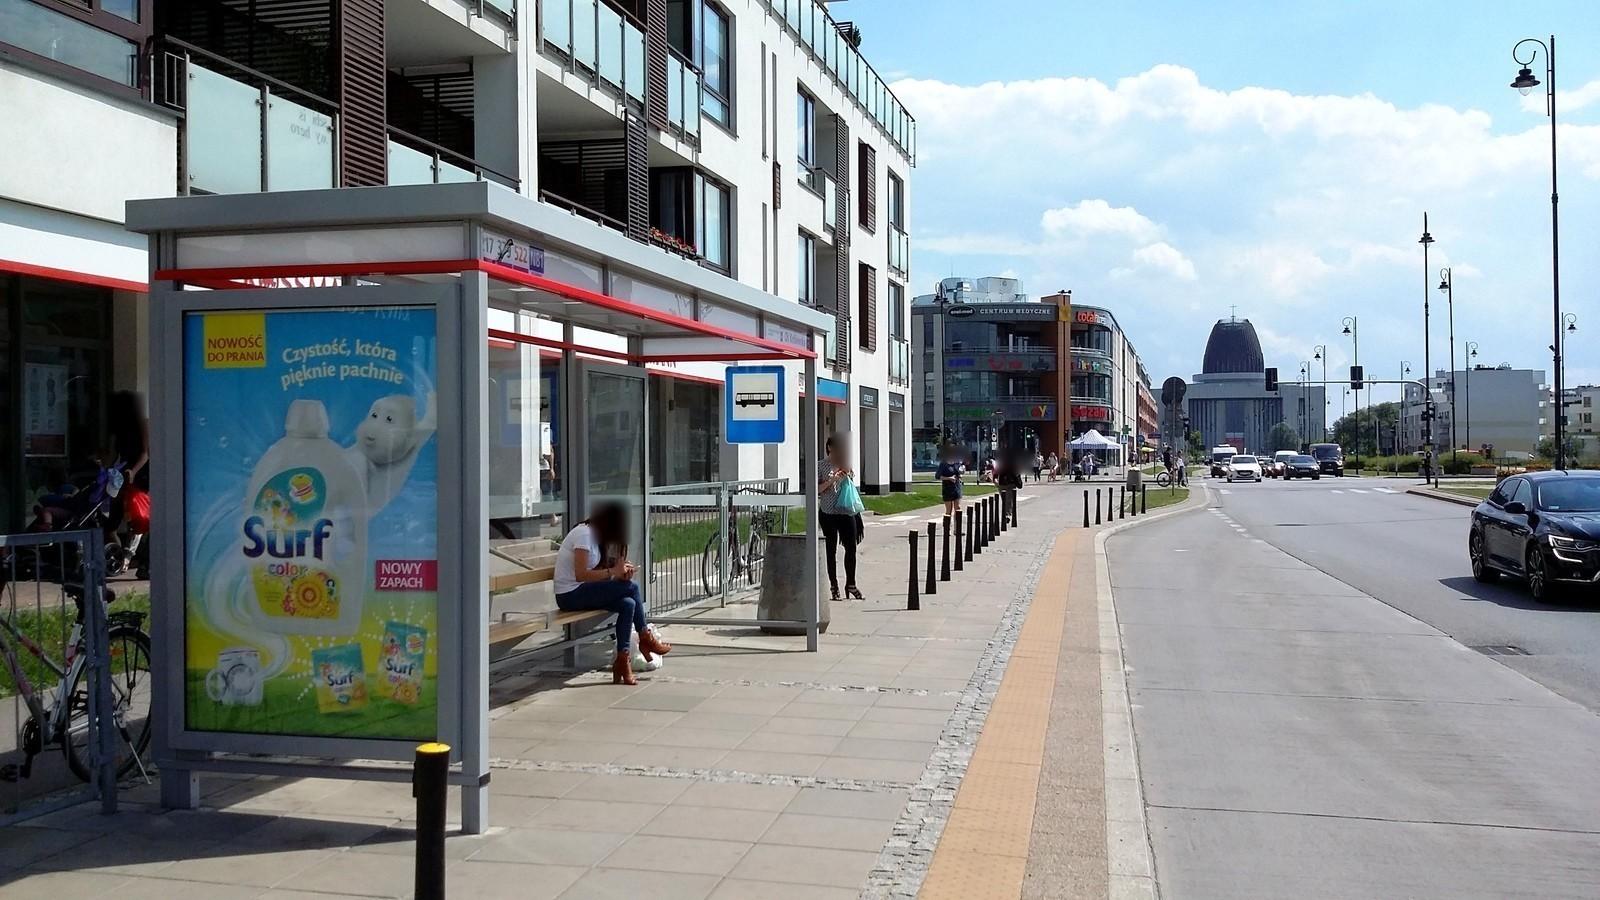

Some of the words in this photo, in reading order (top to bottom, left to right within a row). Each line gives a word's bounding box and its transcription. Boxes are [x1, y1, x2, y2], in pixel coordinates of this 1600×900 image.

[514, 244, 528, 264] 522
[207, 333, 264, 350] NOWOŚĆ
[207, 351, 225, 362] DO
[226, 351, 265, 362] PRANIA
[281, 338, 351, 364] Czystość,
[355, 338, 397, 362] która
[281, 361, 336, 391] pięknie
[339, 361, 404, 385] pachnie
[243, 515, 334, 561] Surf
[268, 561, 308, 577] color
[381, 562, 423, 575] NOWY
[380, 577, 423, 588] ZAPACH
[386, 658, 416, 677] Surf
[327, 671, 354, 687] Surf
